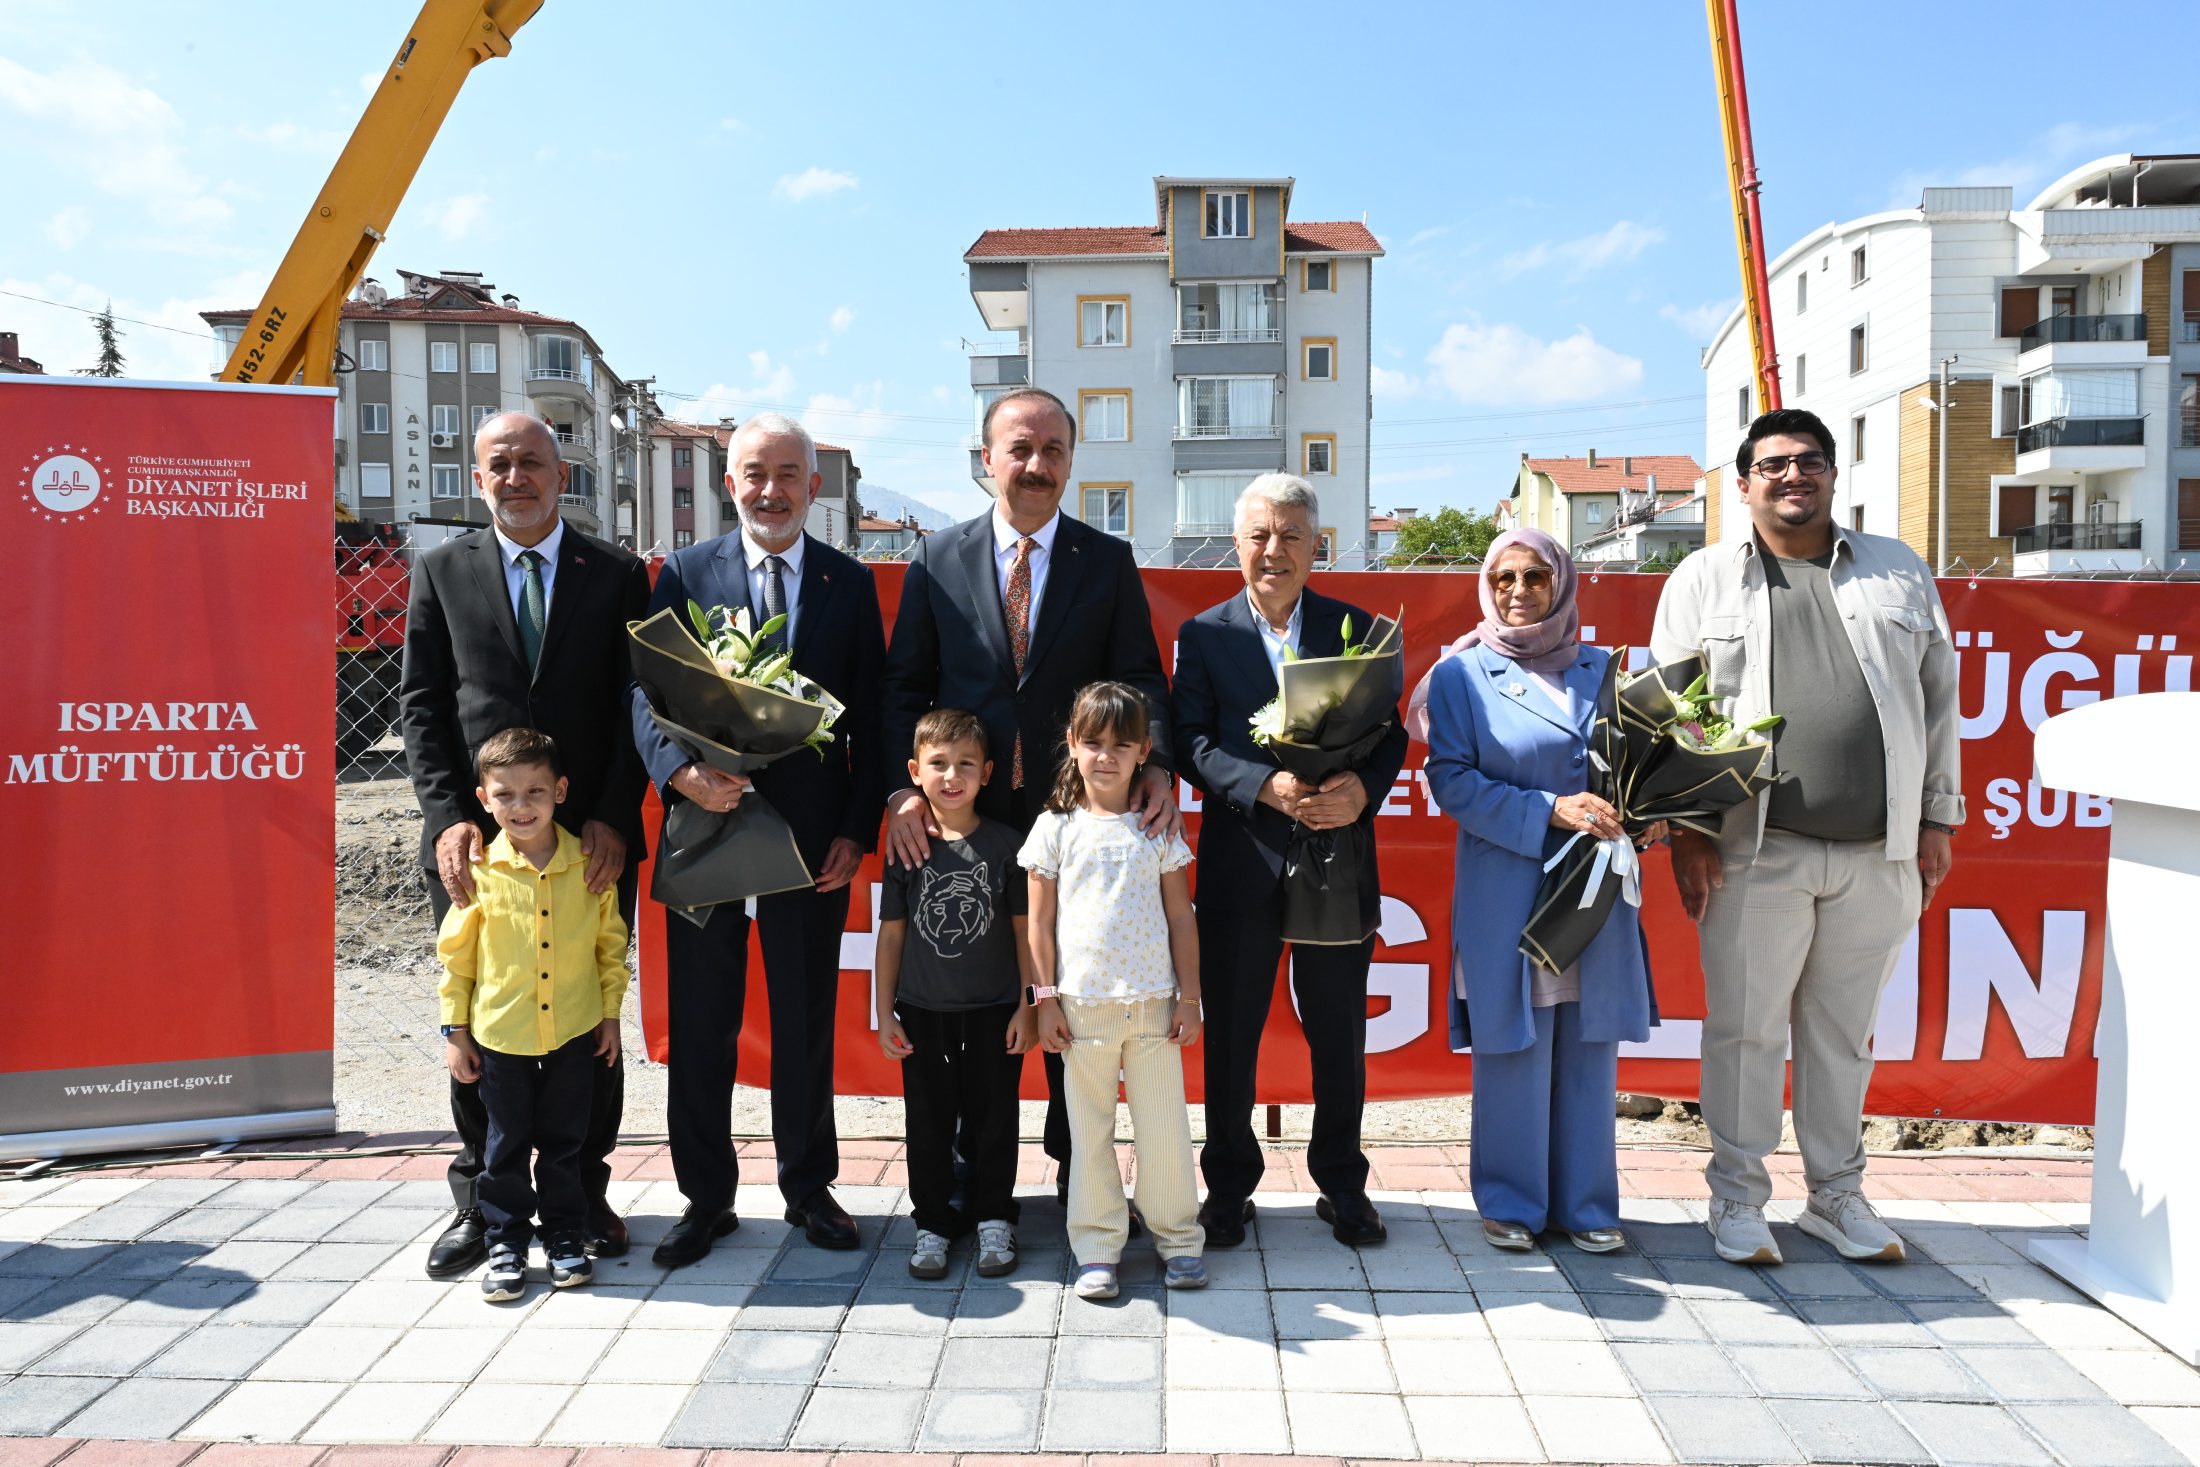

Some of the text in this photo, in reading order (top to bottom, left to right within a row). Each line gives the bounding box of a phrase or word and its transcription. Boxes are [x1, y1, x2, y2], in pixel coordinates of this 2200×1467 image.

[127, 455, 251, 468] TÜRKİYE CUMHURİYETİ
[127, 466, 237, 477] CUMHURBAŞKANLIĞI
[126, 475, 308, 503] DİYANET İŞLERİ
[126, 499, 265, 520] BAŞKANLIĞI
[57, 702, 258, 732] ISPARTA
[4, 743, 306, 784] MÜFTÜLÜĞÜ
[64, 1072, 233, 1097] www.diyanet.gov.tr
